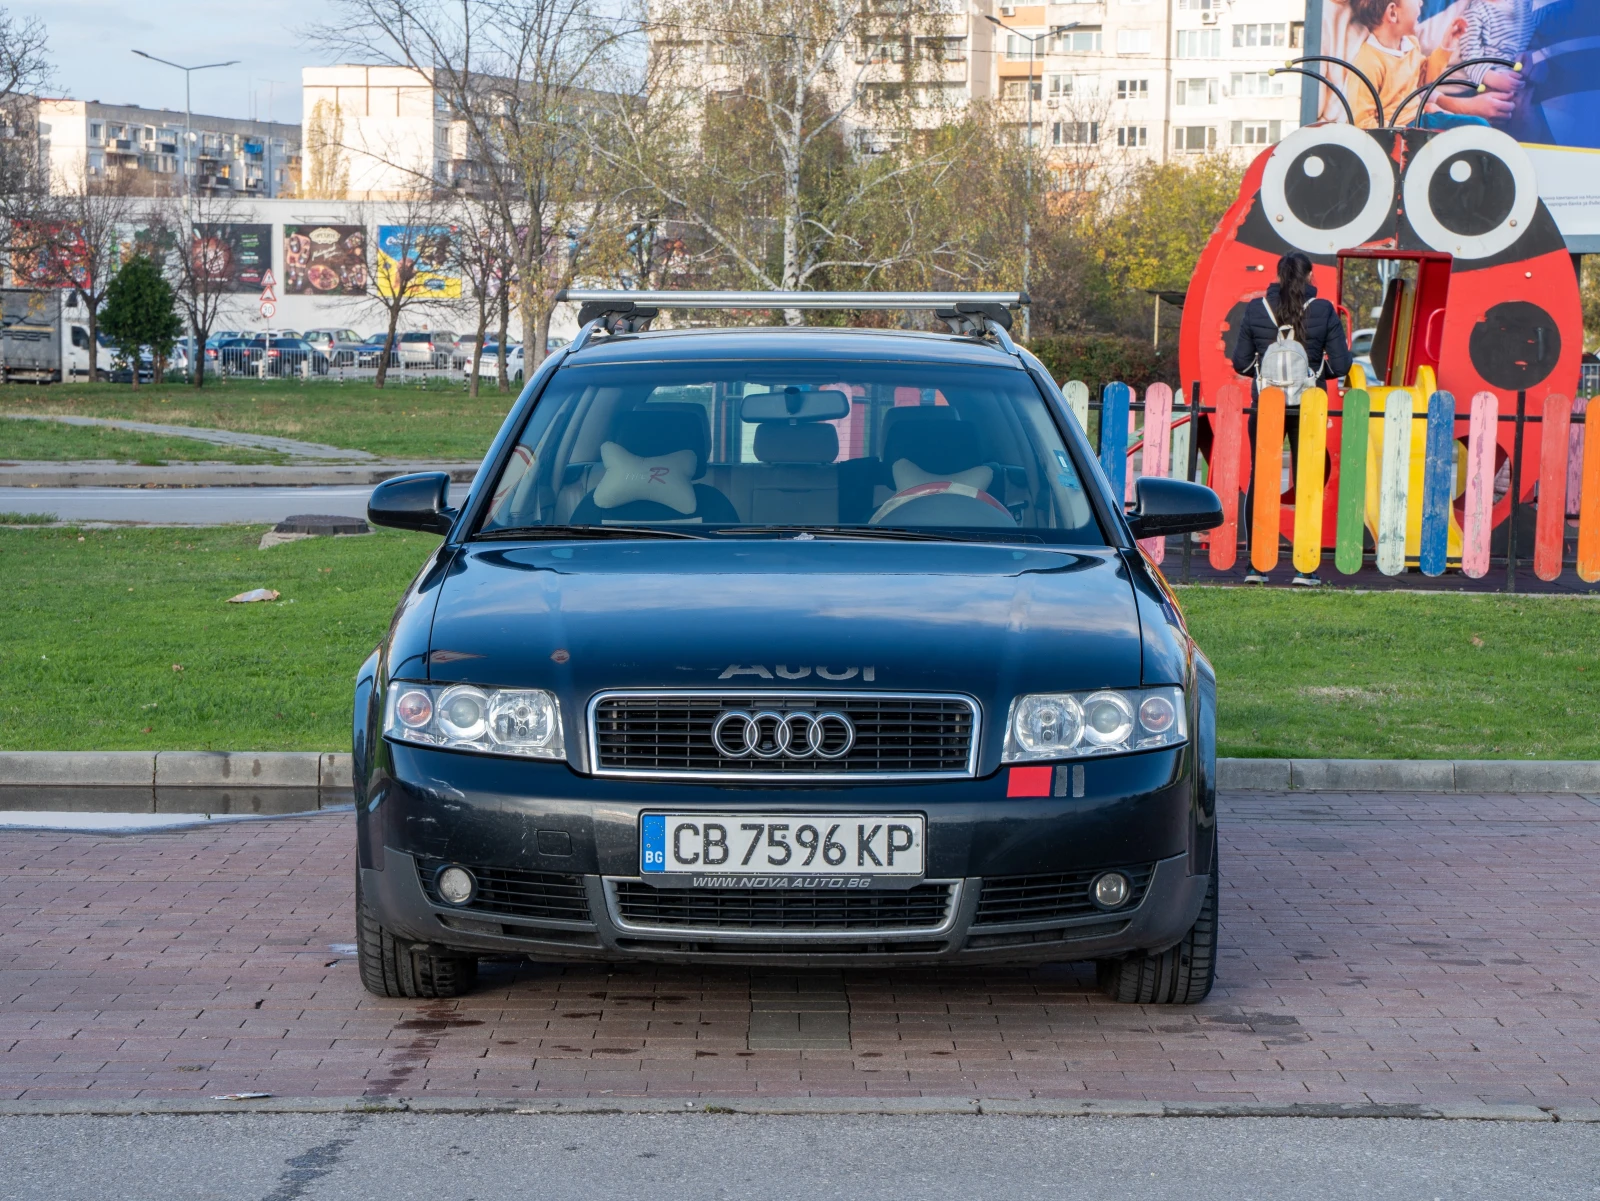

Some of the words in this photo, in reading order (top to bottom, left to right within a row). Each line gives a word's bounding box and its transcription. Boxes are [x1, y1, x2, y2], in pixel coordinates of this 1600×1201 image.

[263, 305, 272, 314] 30
[648, 466, 670, 484] R
[673, 822, 729, 865] CB
[740, 823, 847, 866] 7596
[857, 824, 914, 867] KP
[645, 851, 663, 863] BG
